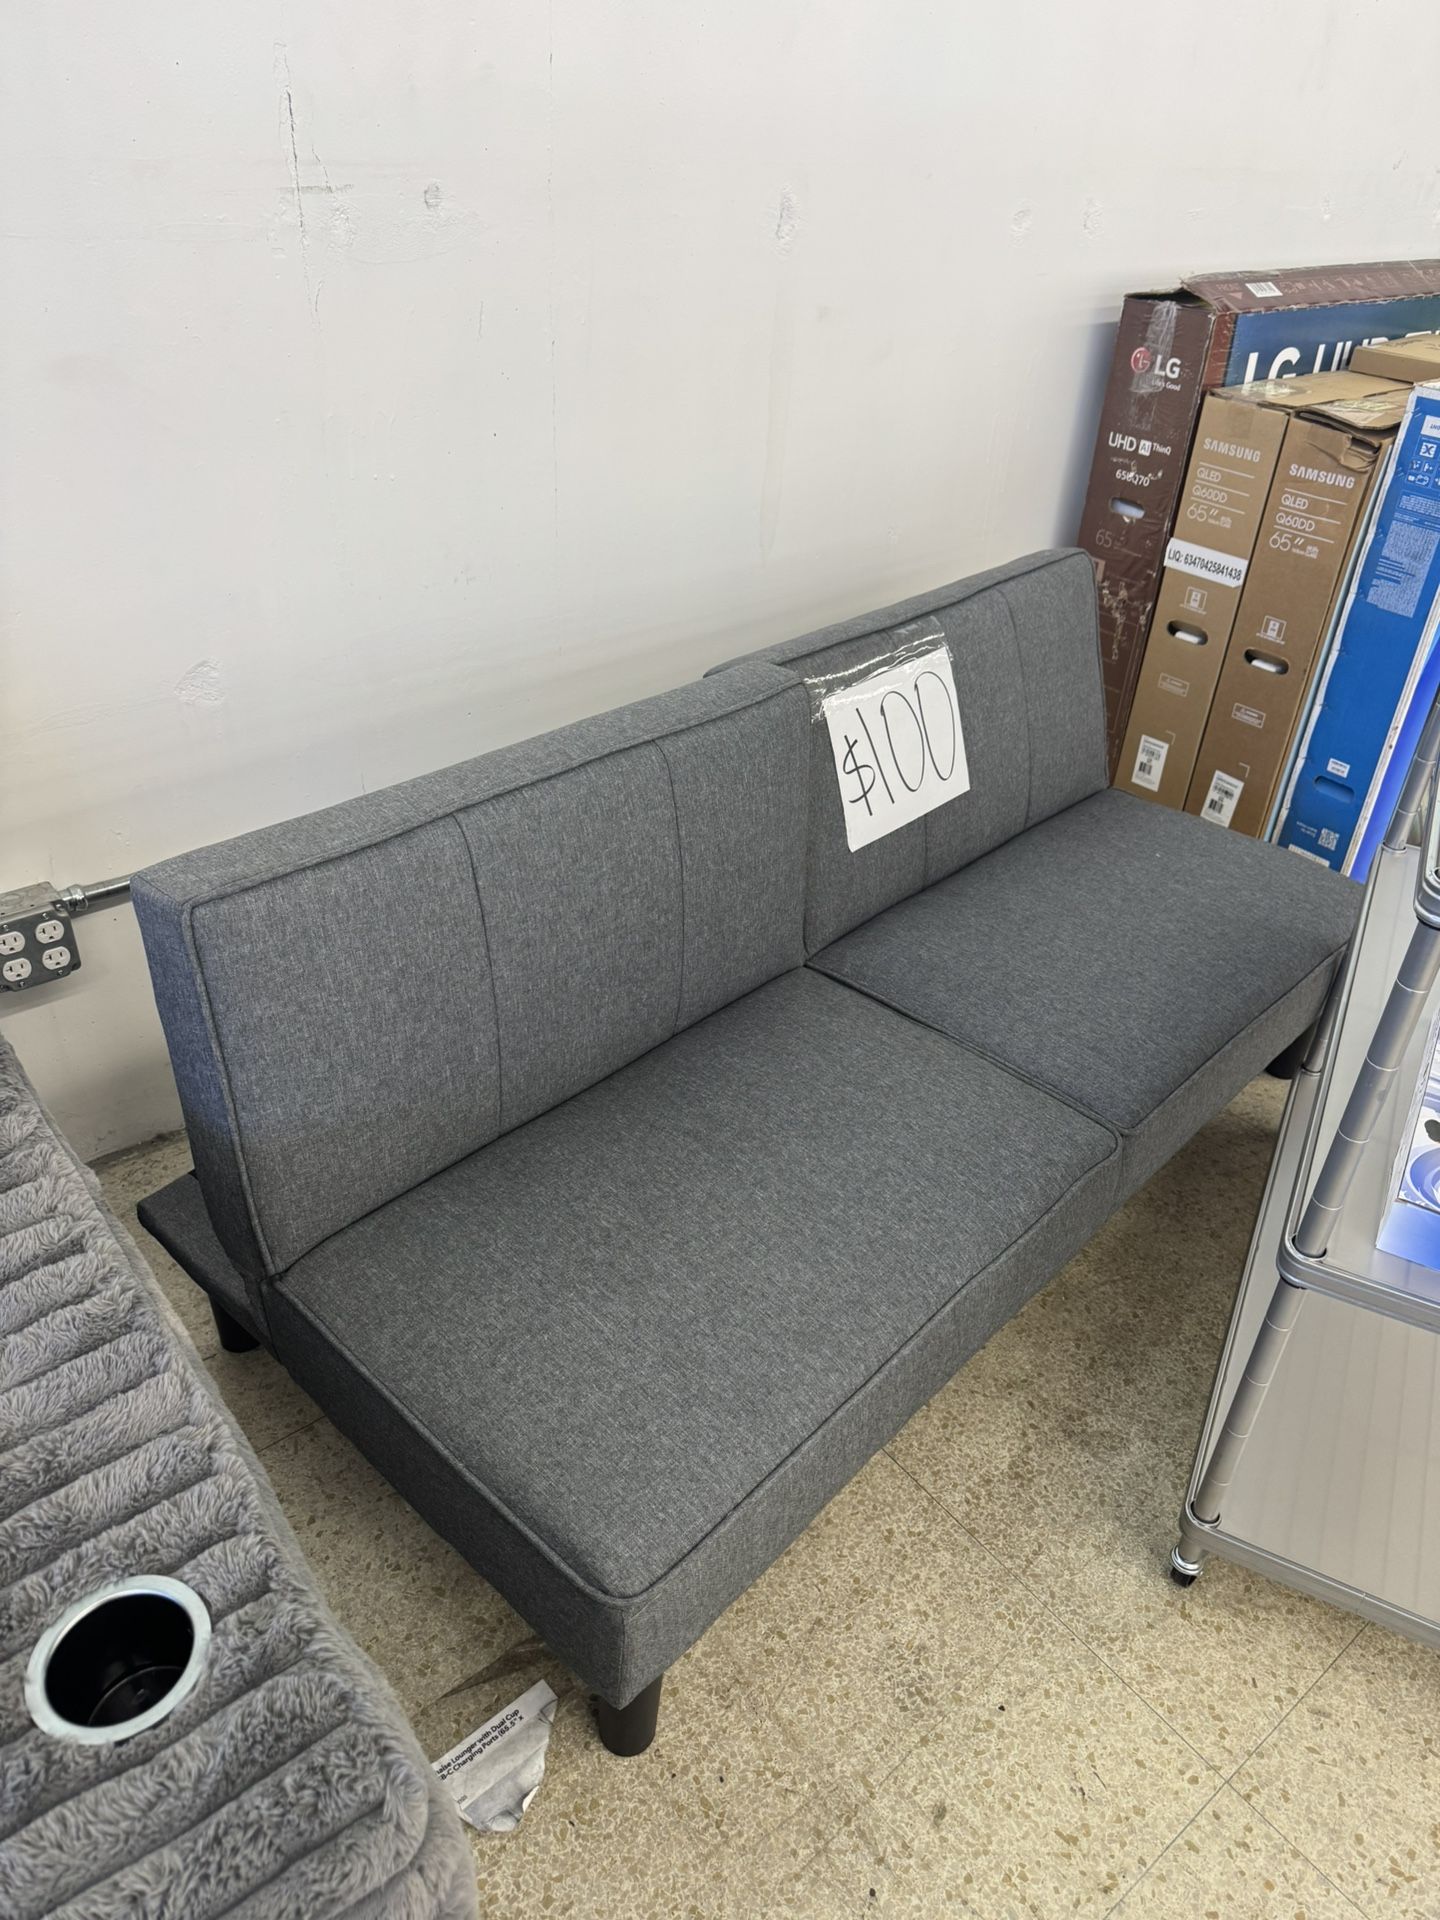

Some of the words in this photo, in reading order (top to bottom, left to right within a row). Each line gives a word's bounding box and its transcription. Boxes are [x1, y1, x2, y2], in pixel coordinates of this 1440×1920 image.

[1154, 354, 1181, 379] LG
[1166, 381, 1181, 392] Good
[1108, 431, 1137, 452] UHD
[1139, 440, 1152, 456] AI
[1152, 443, 1172, 456] ThinQ
[1203, 438, 1261, 463] SAMSUNG
[1197, 467, 1222, 482] QLED
[1289, 463, 1355, 489] SAMSUNG
[1281, 494, 1309, 510] QLED
[1095, 529, 1113, 548] 65
[1168, 548, 1184, 563] LIQ:
[843, 670, 956, 817] $100
[450, 1740, 478, 1764] Lounger
[476, 1729, 492, 1744] with
[490, 1718, 507, 1732] Dual
[505, 1709, 520, 1721] Cup
[452, 1747, 483, 1773] Charging
[481, 1735, 499, 1750] Ports
